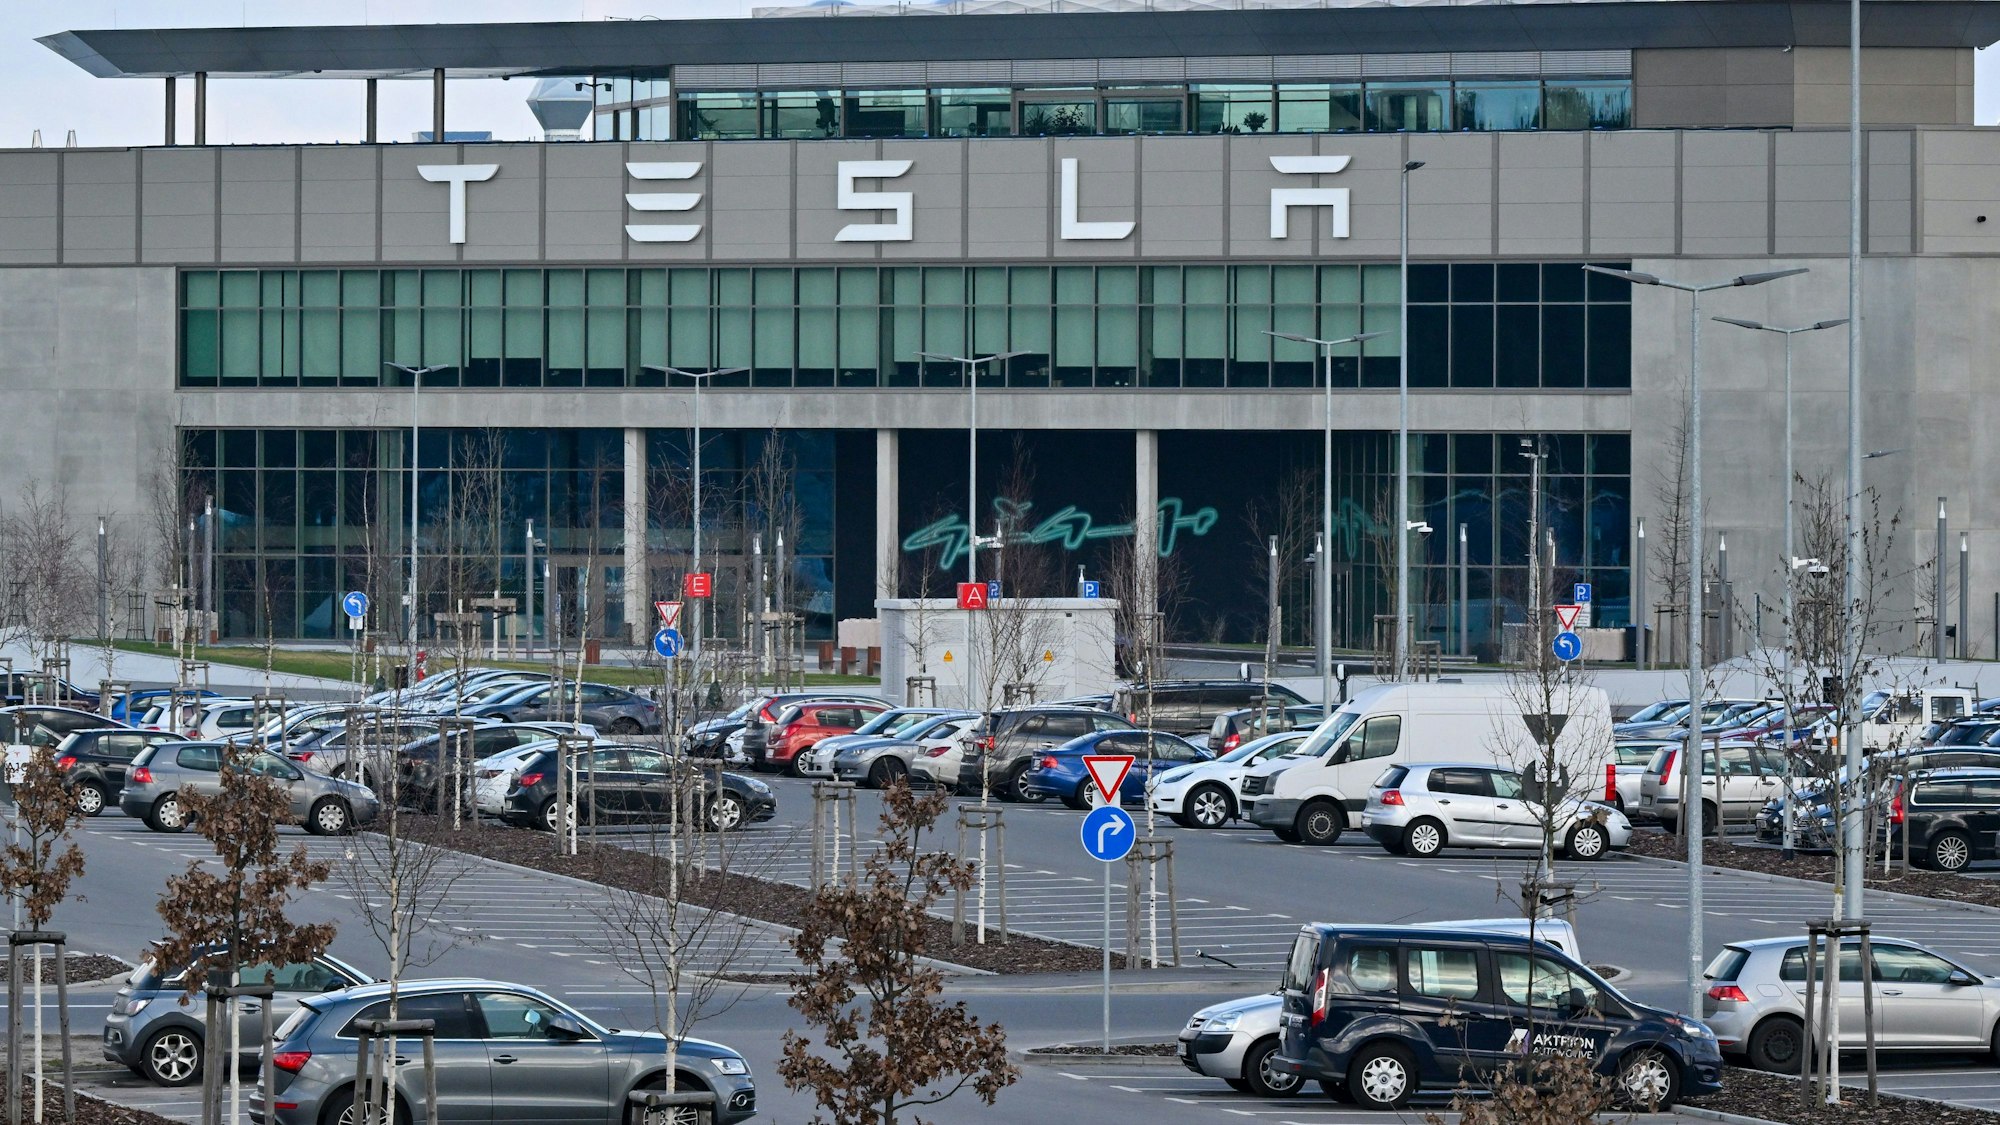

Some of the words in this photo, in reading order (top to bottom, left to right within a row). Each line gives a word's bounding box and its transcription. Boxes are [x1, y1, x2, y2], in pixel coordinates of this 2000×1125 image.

[418, 156, 1351, 244] TESLA
[693, 576, 704, 592] E
[1085, 584, 1095, 597] P
[967, 586, 983, 603] A
[1577, 586, 1586, 600] P
[1533, 1034, 1595, 1049] AKTRION
[1533, 1047, 1593, 1059] AUTOMOIVE
